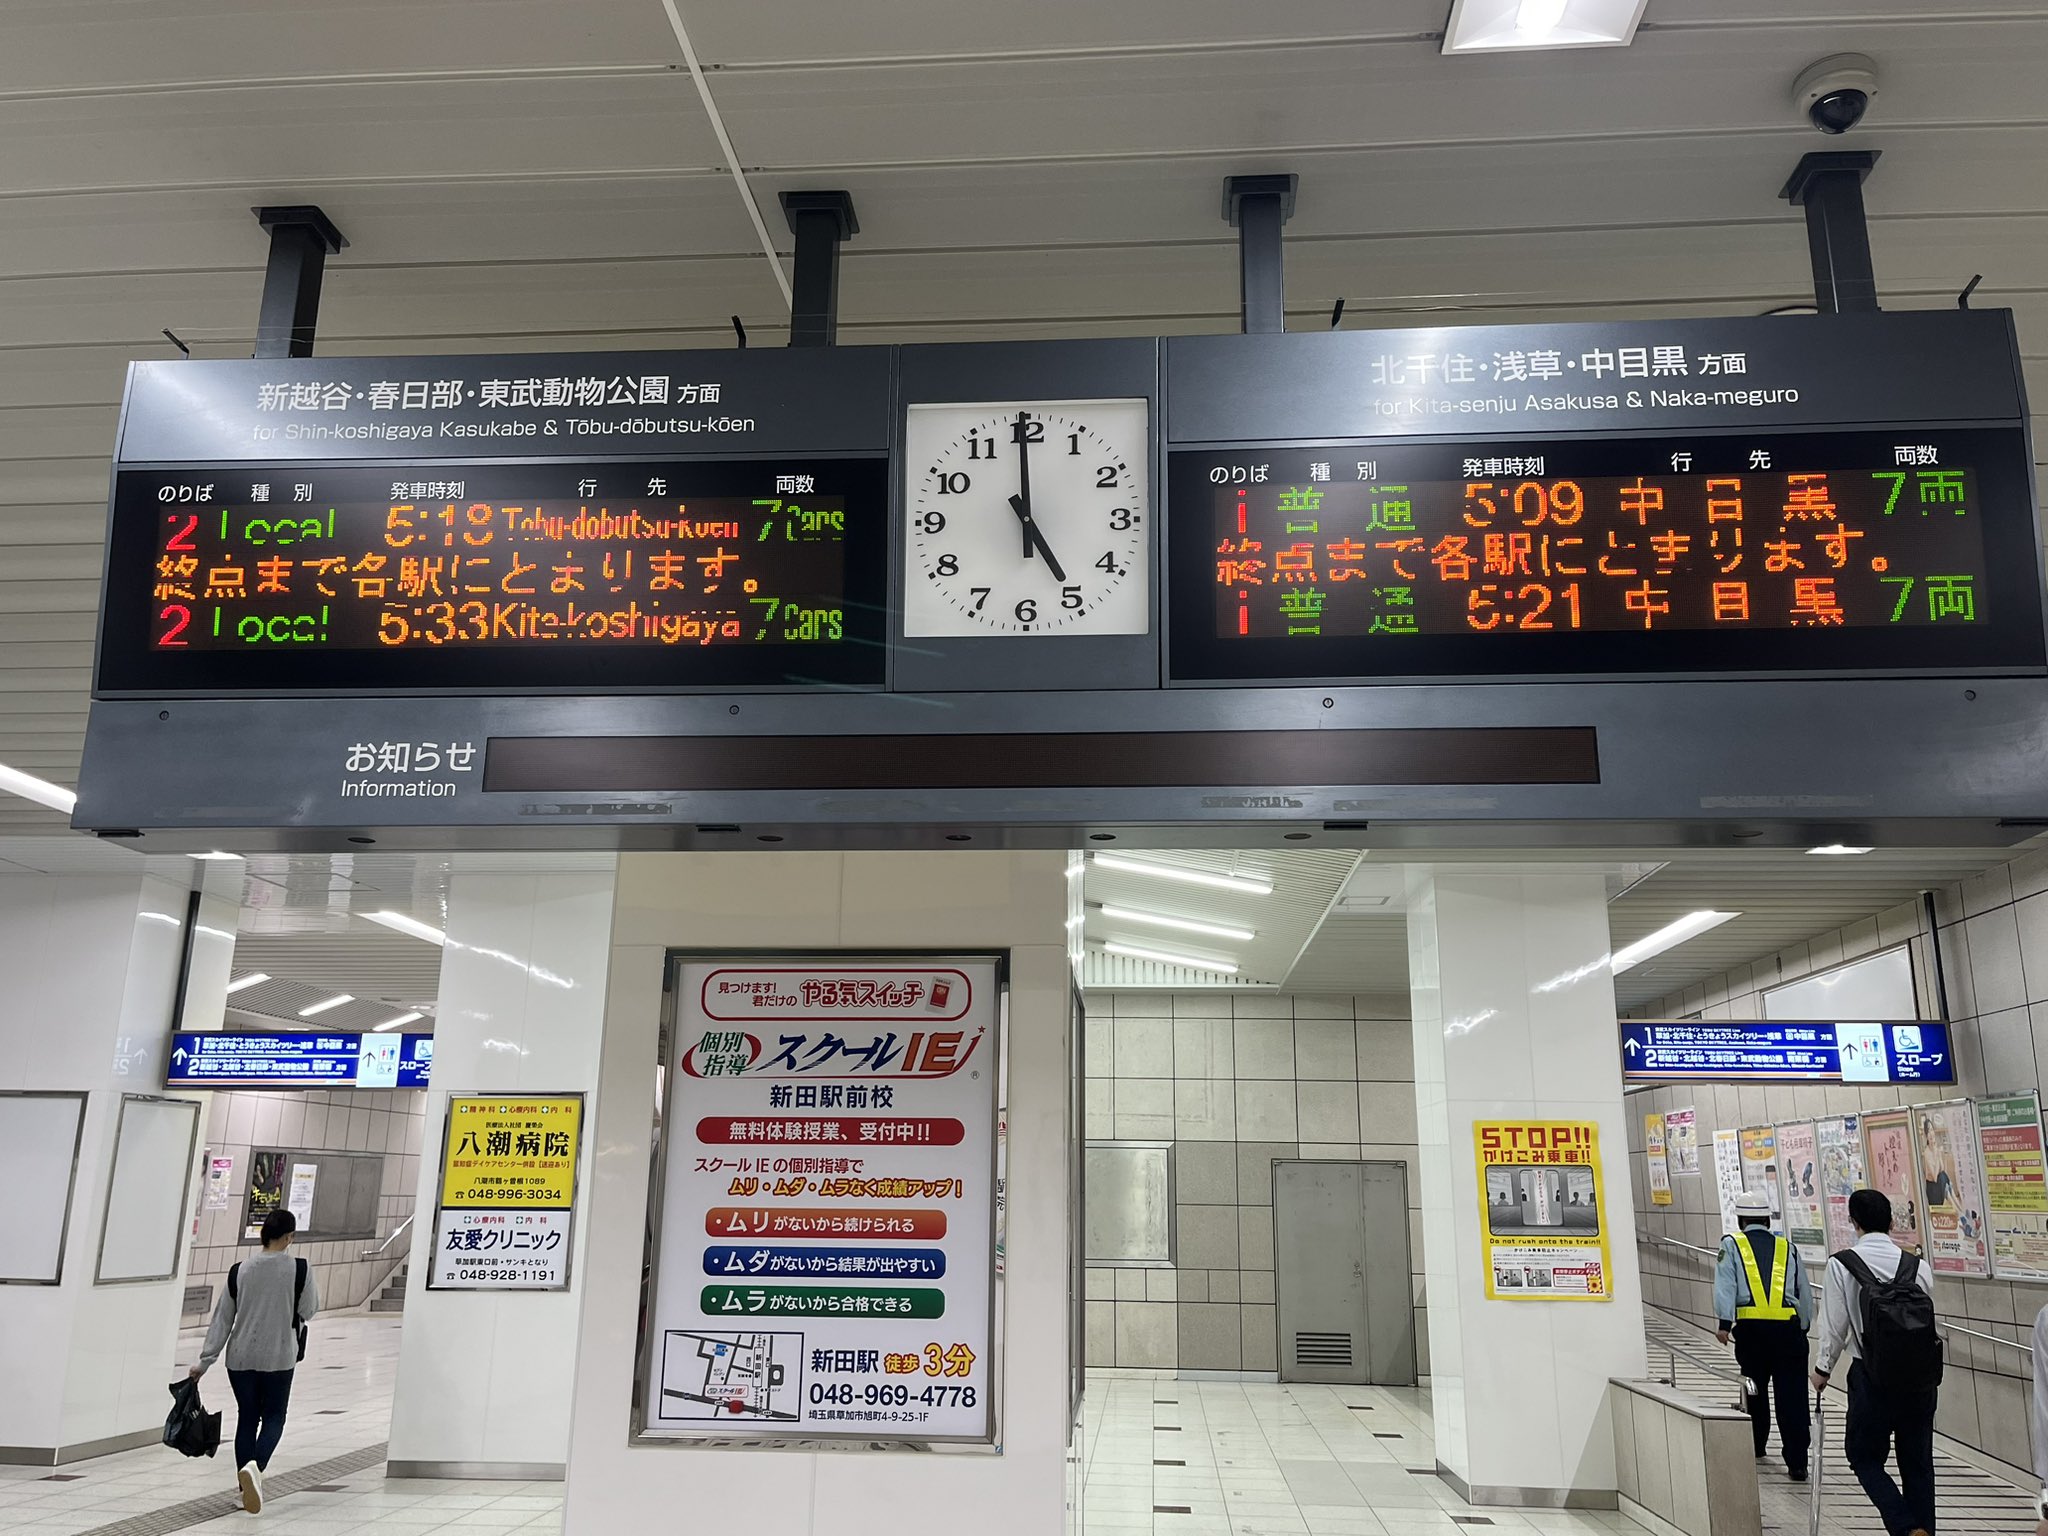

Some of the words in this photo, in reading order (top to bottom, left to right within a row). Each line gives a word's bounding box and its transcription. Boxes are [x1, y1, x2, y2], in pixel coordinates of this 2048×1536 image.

[1371, 345, 1689, 385] 北千住・浅草・中目黒
[1697, 353, 1748, 375] 方面
[256, 375, 670, 412] 新越谷・春日部・東武動物公園
[677, 383, 721, 404] 方面
[1374, 398, 1404, 416] for
[1409, 395, 1517, 416] Kita-senju
[1524, 393, 1619, 412] Asakusa
[1626, 391, 1644, 408] &
[1650, 388, 1800, 408] Naka-meguro
[253, 424, 278, 441] for
[285, 422, 433, 441] Shin-koshigaya
[440, 419, 537, 438] Kasukabe
[543, 420, 559, 436] &
[566, 416, 755, 435] Tōbu-dōbutsu-kōen
[1010, 421, 1044, 443] 12
[968, 438, 997, 459] 11
[1067, 434, 1081, 455] 1
[1210, 464, 1269, 484] のりば
[1462, 456, 1545, 478] 発車時刻
[1894, 445, 1939, 466] 両数
[158, 483, 214, 502] のりば
[390, 480, 465, 500] 発車時刻
[776, 475, 815, 494] 両数
[937, 472, 971, 494] 10
[1096, 466, 1119, 488] 2
[923, 511, 946, 534] 9
[1109, 508, 1131, 530] 3
[166, 514, 198, 550] 2
[936, 554, 959, 576] 8
[1095, 551, 1119, 573] 4
[970, 587, 991, 610] 7
[1061, 585, 1083, 608] 5
[1014, 599, 1037, 622] 6
[159, 604, 191, 645] 2
[345, 742, 476, 773] お知らせ
[341, 780, 456, 797] Information
[752, 994, 797, 1007] 君だけの
[800, 979, 925, 1007] やる気スイッチ
[699, 1031, 745, 1053] 個別
[703, 1054, 749, 1077] 指導
[1645, 1049, 1658, 1067] 2
[1896, 1053, 1943, 1066] スロープ
[769, 1084, 894, 1109] 新田駅前校
[456, 1131, 570, 1157] 八潮病院
[1482, 1127, 1591, 1149] STOP!!
[467, 1189, 562, 1200] 048-996-3034
[445, 1228, 562, 1251] 友愛クリニック
[460, 1269, 555, 1281] 048-928-1191
[811, 1349, 879, 1373] 新田駅
[809, 1382, 978, 1408] 048-969-4778
